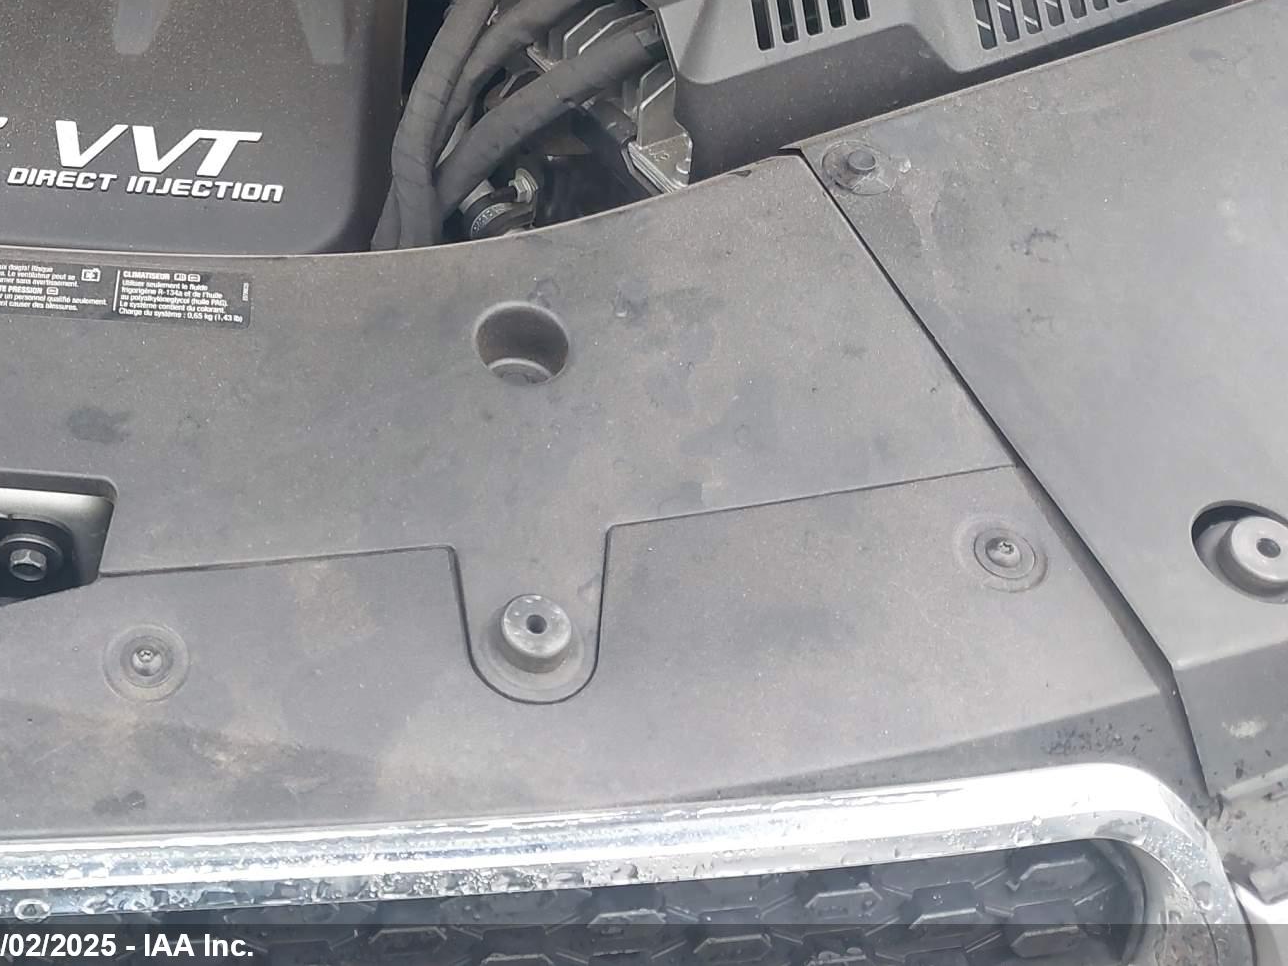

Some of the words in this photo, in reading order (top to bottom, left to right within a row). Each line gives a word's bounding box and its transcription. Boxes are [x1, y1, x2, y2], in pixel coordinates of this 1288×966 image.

[55, 120, 262, 177] VVT
[7, 167, 116, 191] DIRECT
[126, 176, 284, 203] INJECTION
[18, 271, 50, 279] ventilateur
[51, 273, 66, 282] peut
[124, 271, 170, 280] CLIMATISEUR
[32, 279, 79, 287] avertissement.
[146, 281, 180, 289] seulement
[8, 285, 42, 293] PRESSION
[14, 293, 45, 302] personnel
[72, 296, 107, 304] seulement.
[191, 298, 209, 306] (huile
[46, 301, 78, 309] blessures.
[129, 302, 157, 310] système
[197, 305, 225, 313] colorant.
[119, 308, 142, 317] Charge
[154, 310, 182, 319] système
[187, 312, 202, 320] 0,65
[204, 313, 213, 321] kg
[215, 314, 232, 322] (1,43
